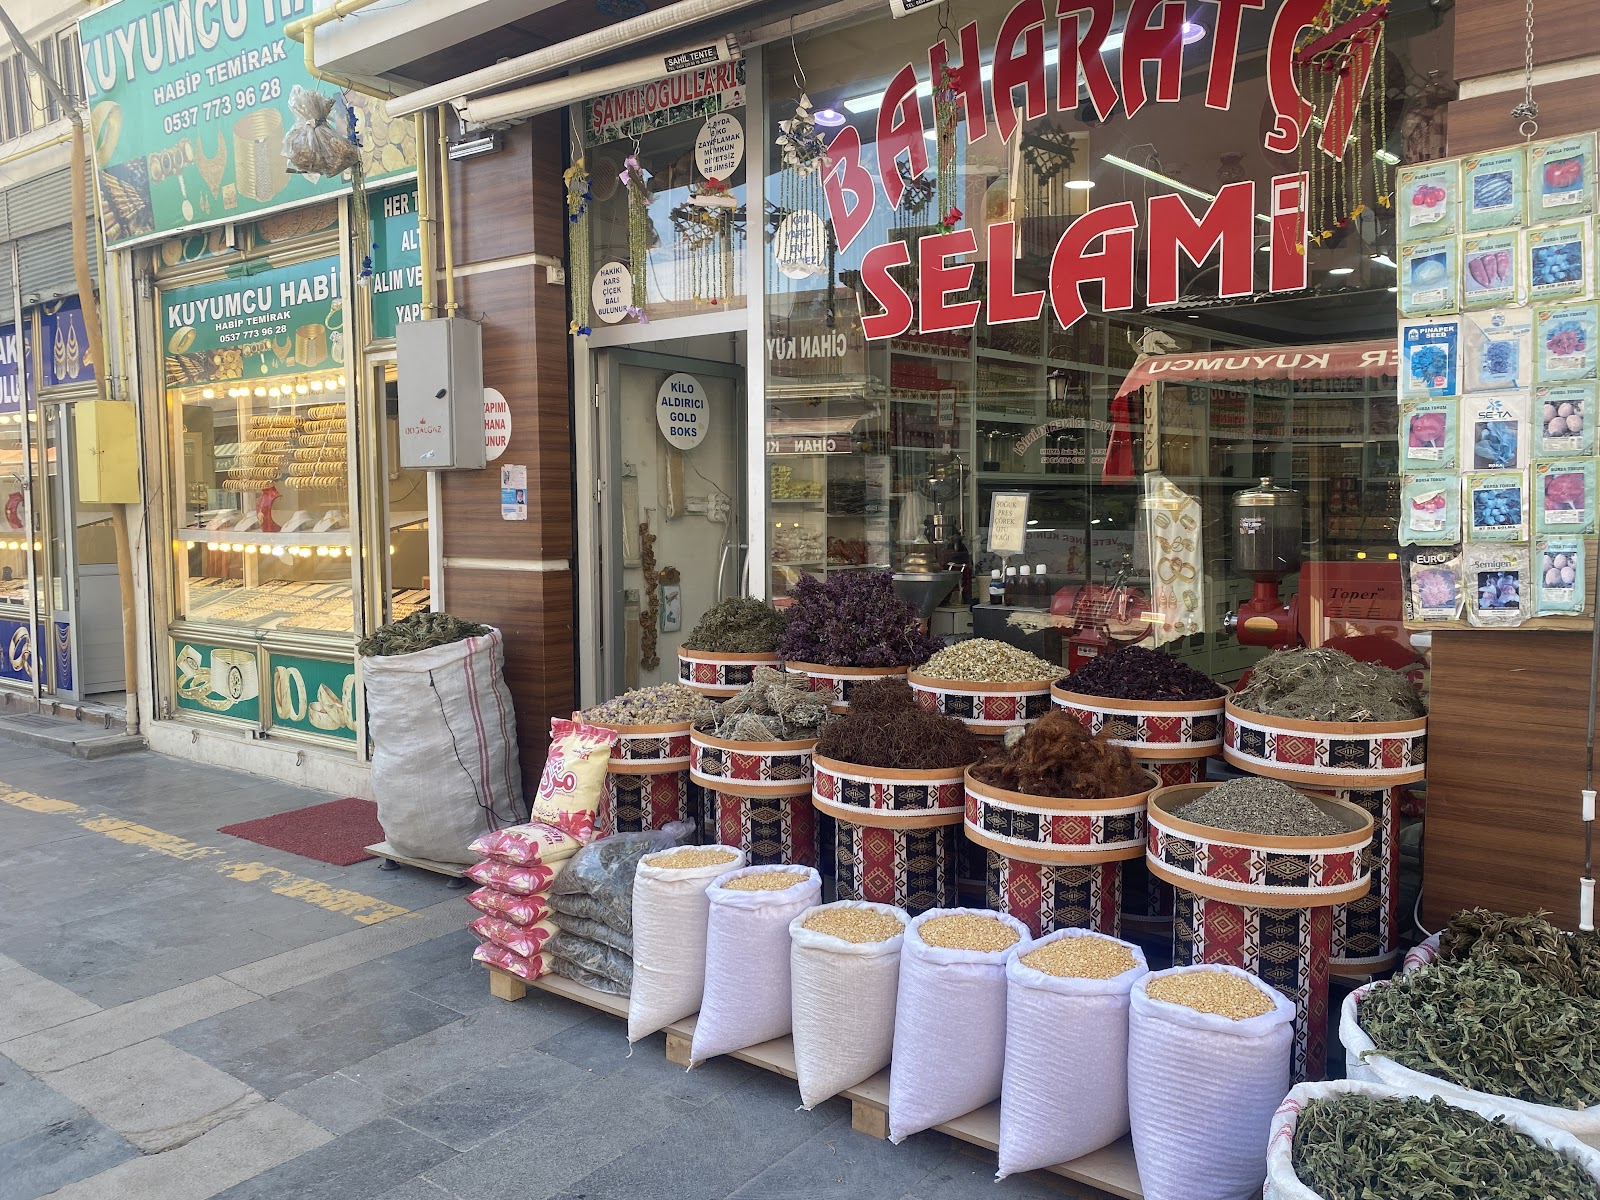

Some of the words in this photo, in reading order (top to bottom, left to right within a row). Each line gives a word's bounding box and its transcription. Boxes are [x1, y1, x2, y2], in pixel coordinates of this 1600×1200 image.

[668, 53, 689, 66] SAHİL
[690, 49, 713, 60] TENTE
[153, 72, 201, 105] HABİP
[205, 38, 287, 86] TEMİRAK
[163, 108, 198, 134] 0537
[203, 95, 231, 121] 773
[236, 87, 256, 109] 96
[260, 78, 281, 102] 28
[698, 133, 740, 149] ZAYIFLAMAK
[704, 152, 735, 165] DİYETSİZ
[704, 160, 735, 173] REJİMSİZ
[384, 195, 409, 218] HER
[860, 171, 1308, 340] SELAMİ
[600, 266, 622, 276] HAKİKİ
[374, 268, 403, 294] ALIM
[406, 267, 422, 288] VE
[603, 277, 620, 285] KARS
[168, 285, 272, 328] KUYUMCU
[280, 266, 342, 308] HABİ
[602, 287, 621, 297] ÇİÇEK
[598, 305, 627, 315] BULUNUR
[215, 316, 243, 331] HABİP
[246, 310, 291, 327] TEMİRAK
[219, 333, 240, 343] 0537
[243, 330, 259, 339] 773
[262, 326, 273, 336] 96
[275, 325, 287, 334] 28
[1420, 326, 1454, 334] PINAPER
[671, 381, 694, 393] KİLO
[484, 402, 506, 414] APIMI
[661, 396, 704, 409] ALDIRICI
[670, 411, 696, 422] GOLD
[670, 427, 697, 437] BOKS
[1416, 553, 1446, 564] EURO
[1474, 560, 1512, 569] Semigen
[1330, 587, 1377, 601] Toper
